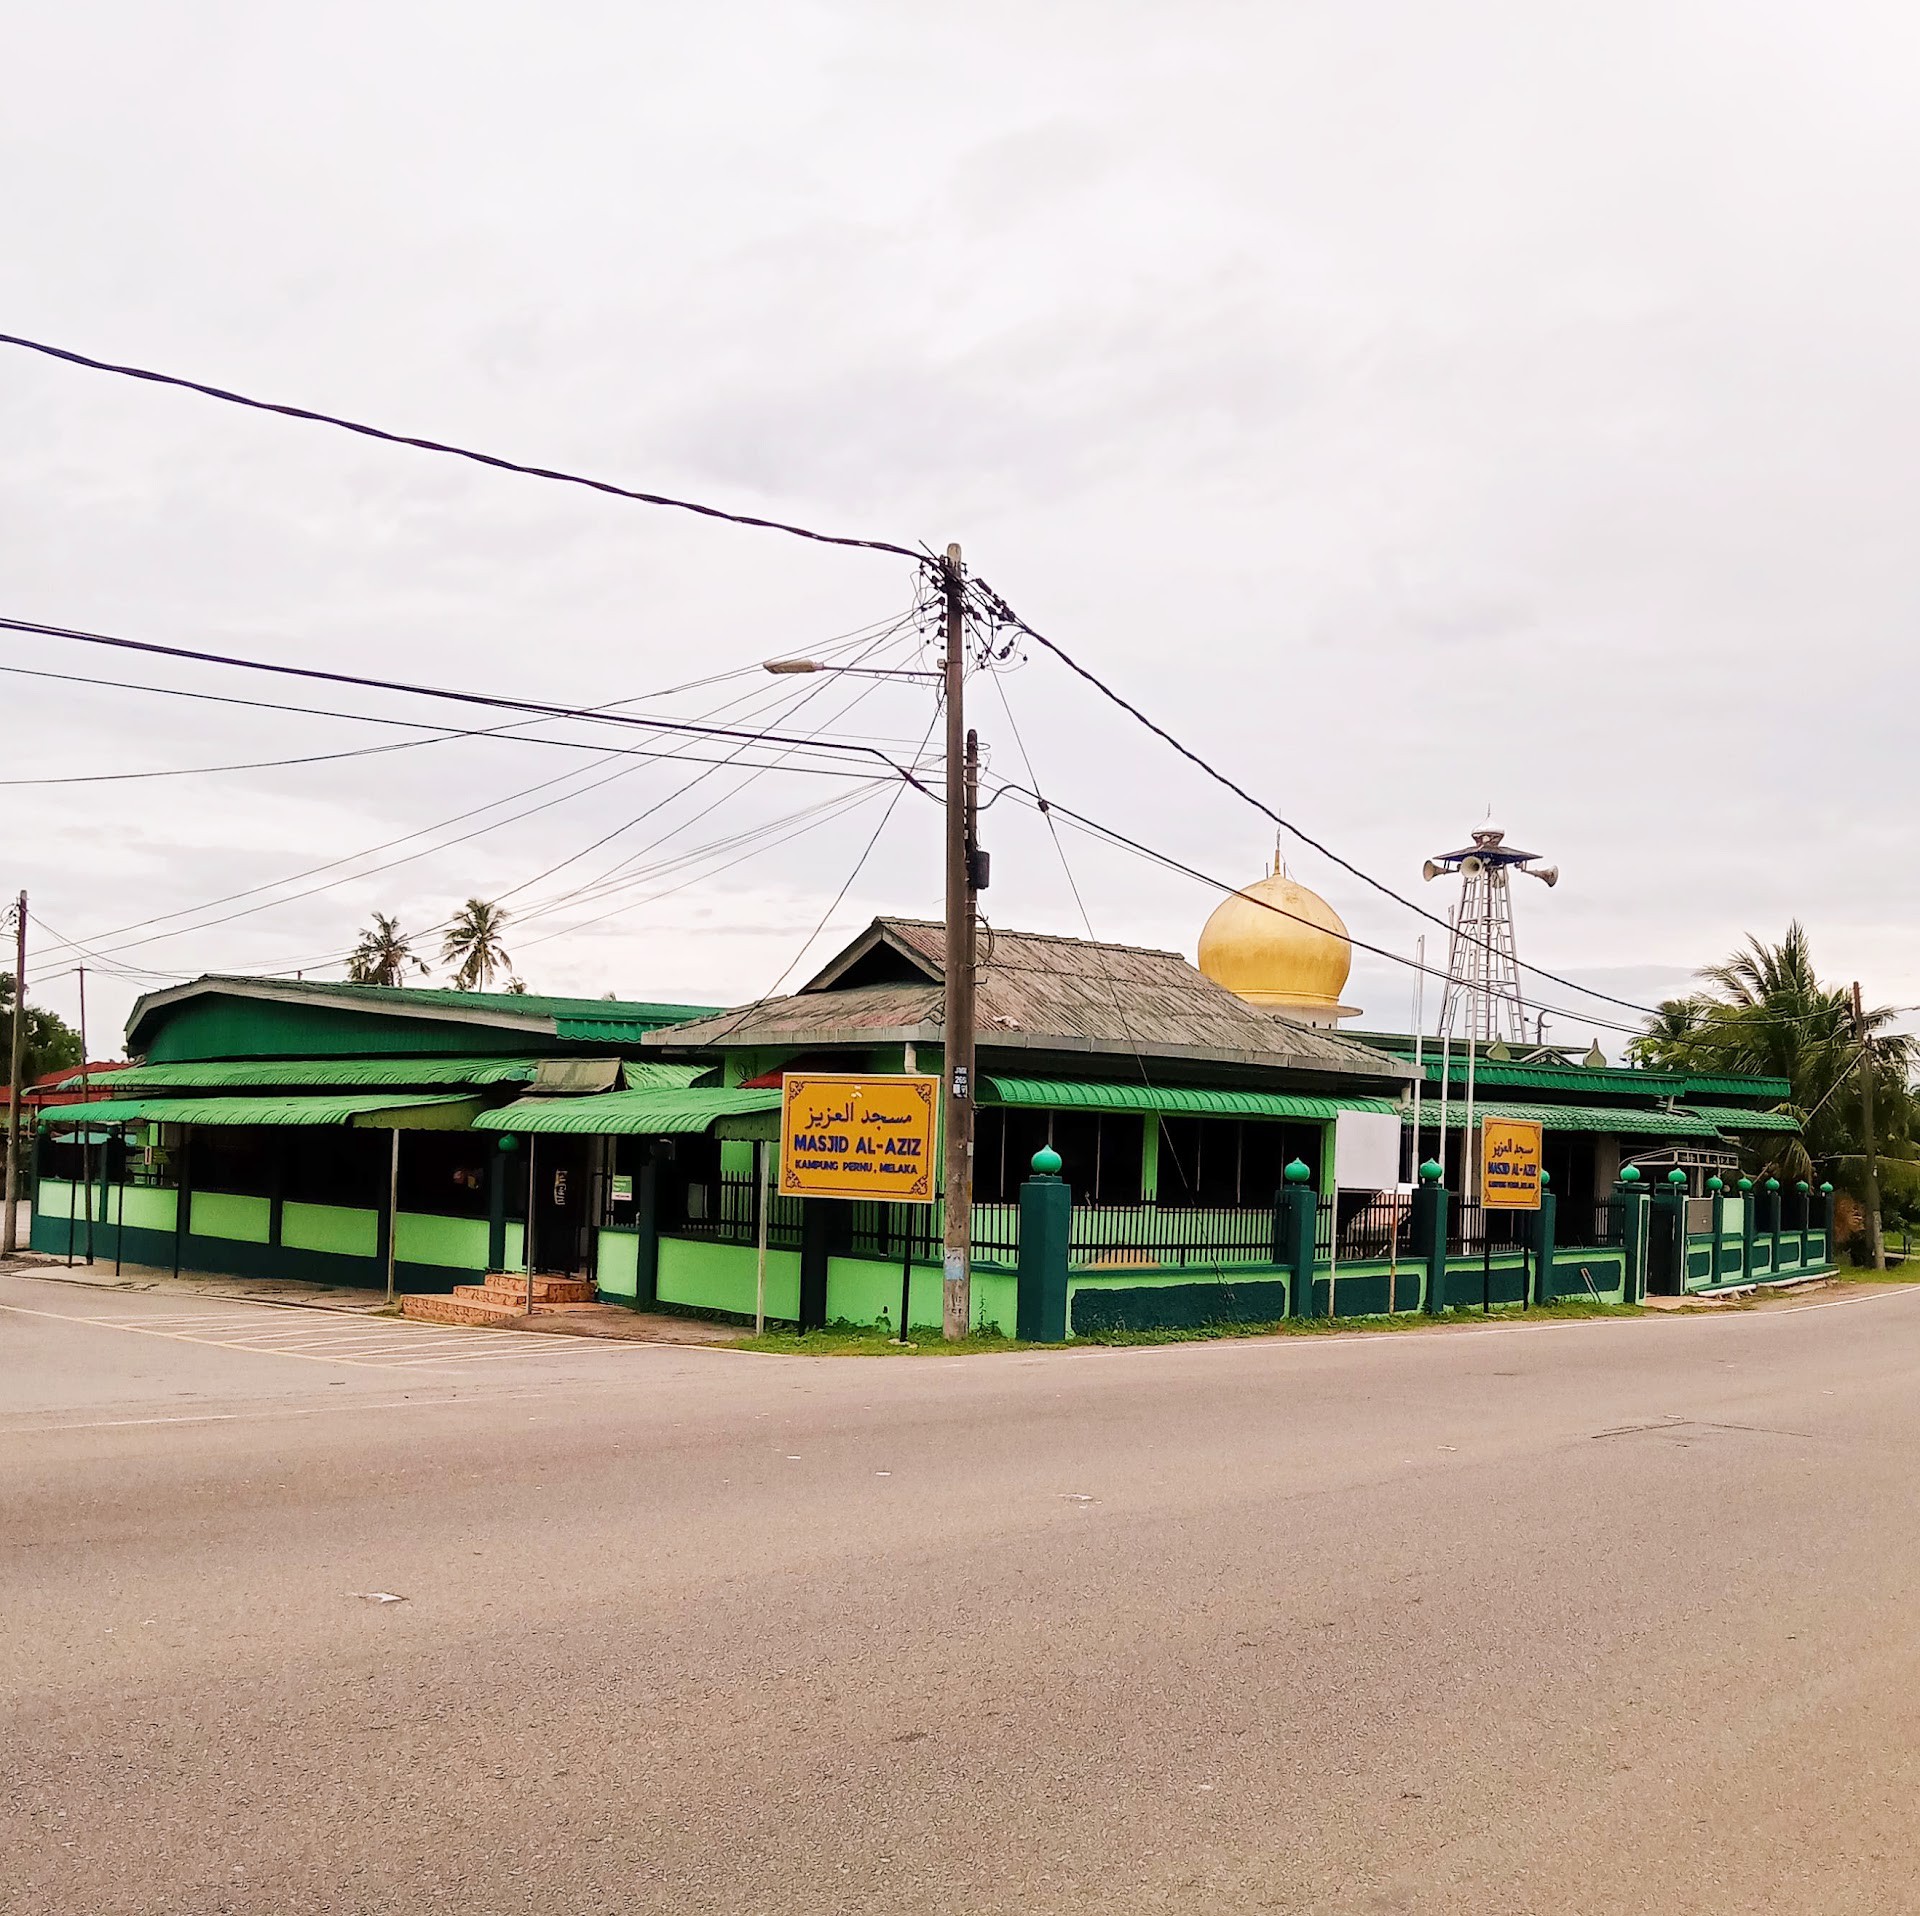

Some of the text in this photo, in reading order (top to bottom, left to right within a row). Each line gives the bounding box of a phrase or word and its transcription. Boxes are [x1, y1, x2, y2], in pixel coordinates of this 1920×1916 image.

[804, 1101, 912, 1131] مسجد العزيز
[794, 1134, 922, 1156] MASJID AL-AZIZ
[795, 1159, 839, 1171] KAMPUNG
[879, 1162, 918, 1175] MELAKA
